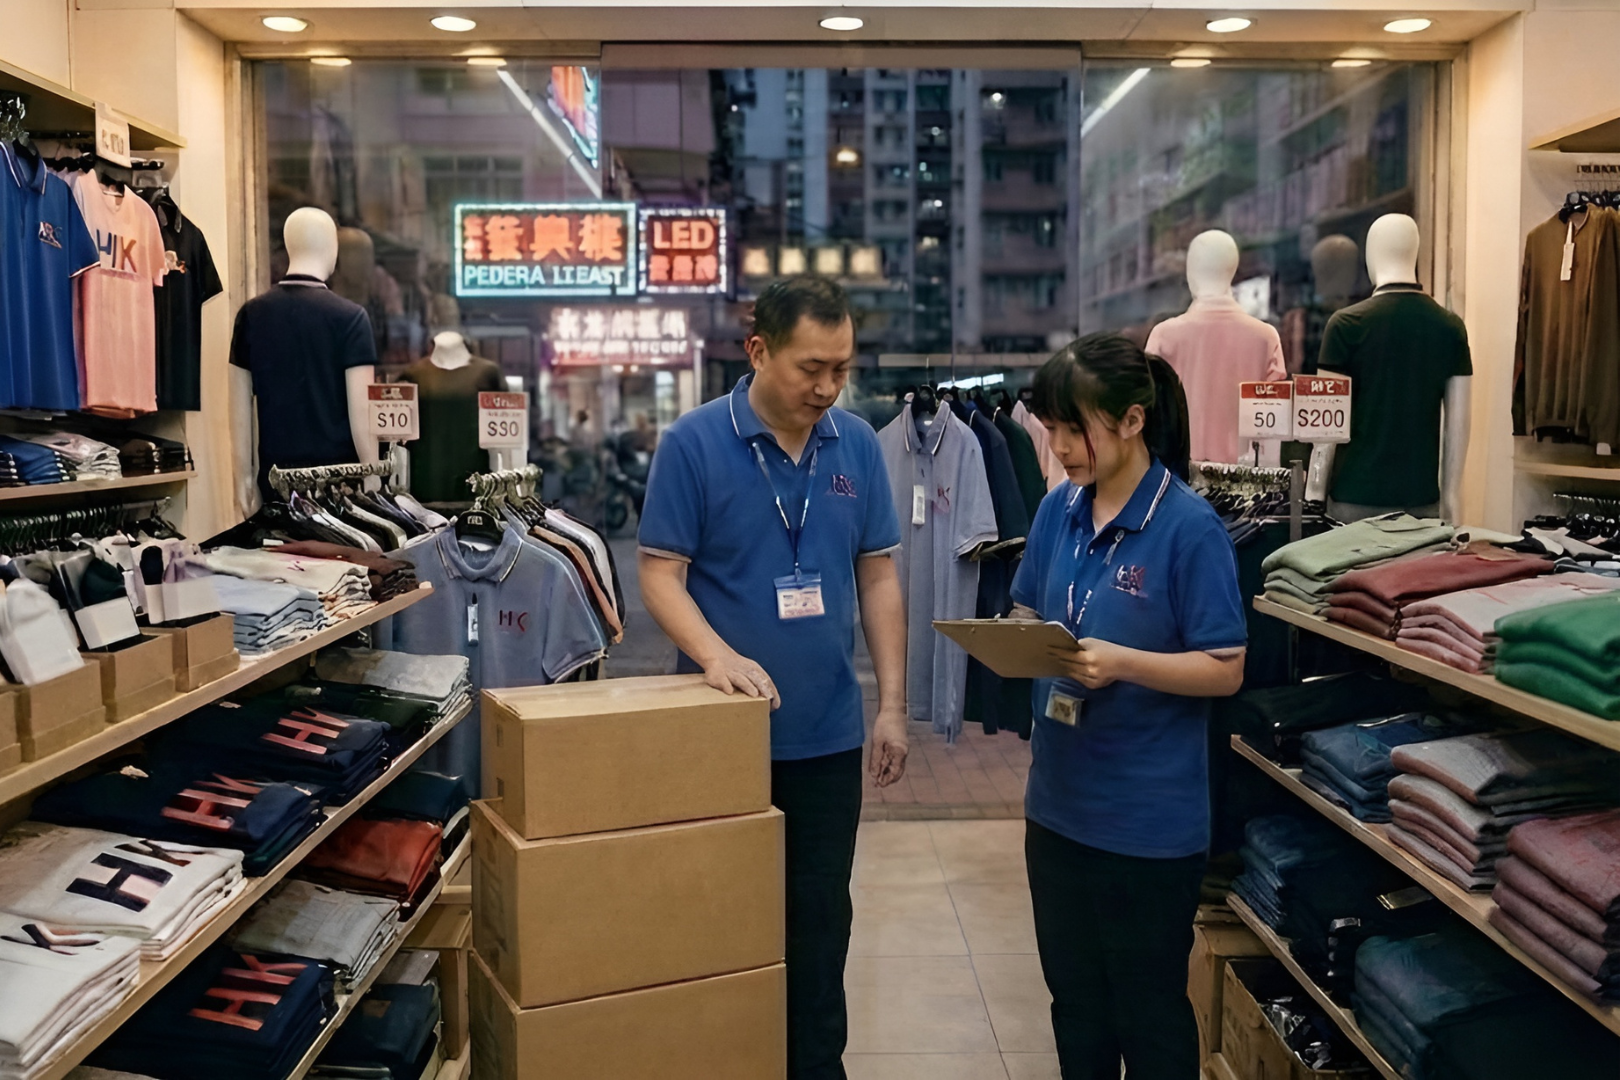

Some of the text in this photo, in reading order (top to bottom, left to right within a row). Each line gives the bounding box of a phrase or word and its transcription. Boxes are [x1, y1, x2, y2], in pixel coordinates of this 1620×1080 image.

[653, 220, 715, 250] LED
[1253, 411, 1277, 429] 50
[188, 953, 309, 1032] HK
